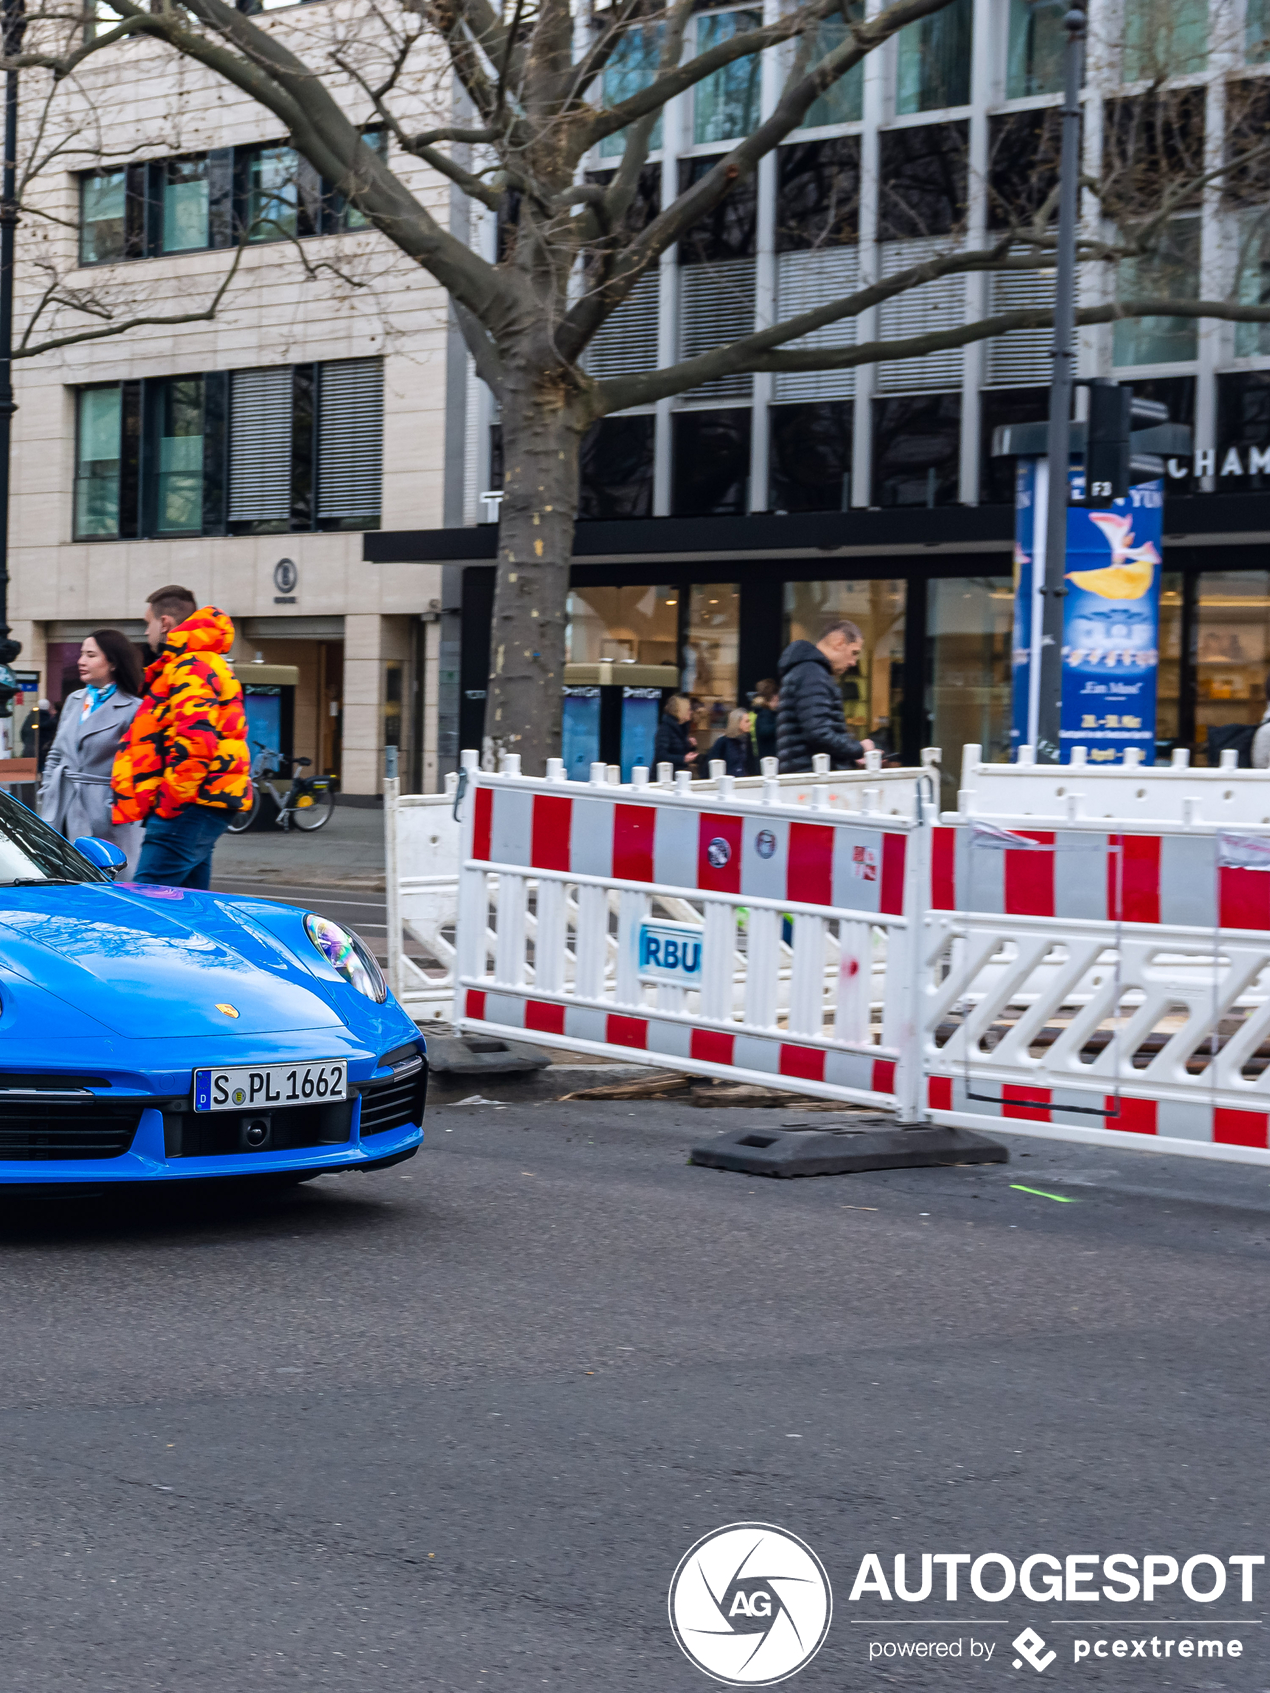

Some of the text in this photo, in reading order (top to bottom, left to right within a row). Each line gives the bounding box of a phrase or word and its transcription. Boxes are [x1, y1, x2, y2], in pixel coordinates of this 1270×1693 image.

[1091, 481, 1113, 497] F3
[645, 936, 700, 973] RBU
[200, 1094, 207, 1104] D
[213, 1075, 230, 1104] S
